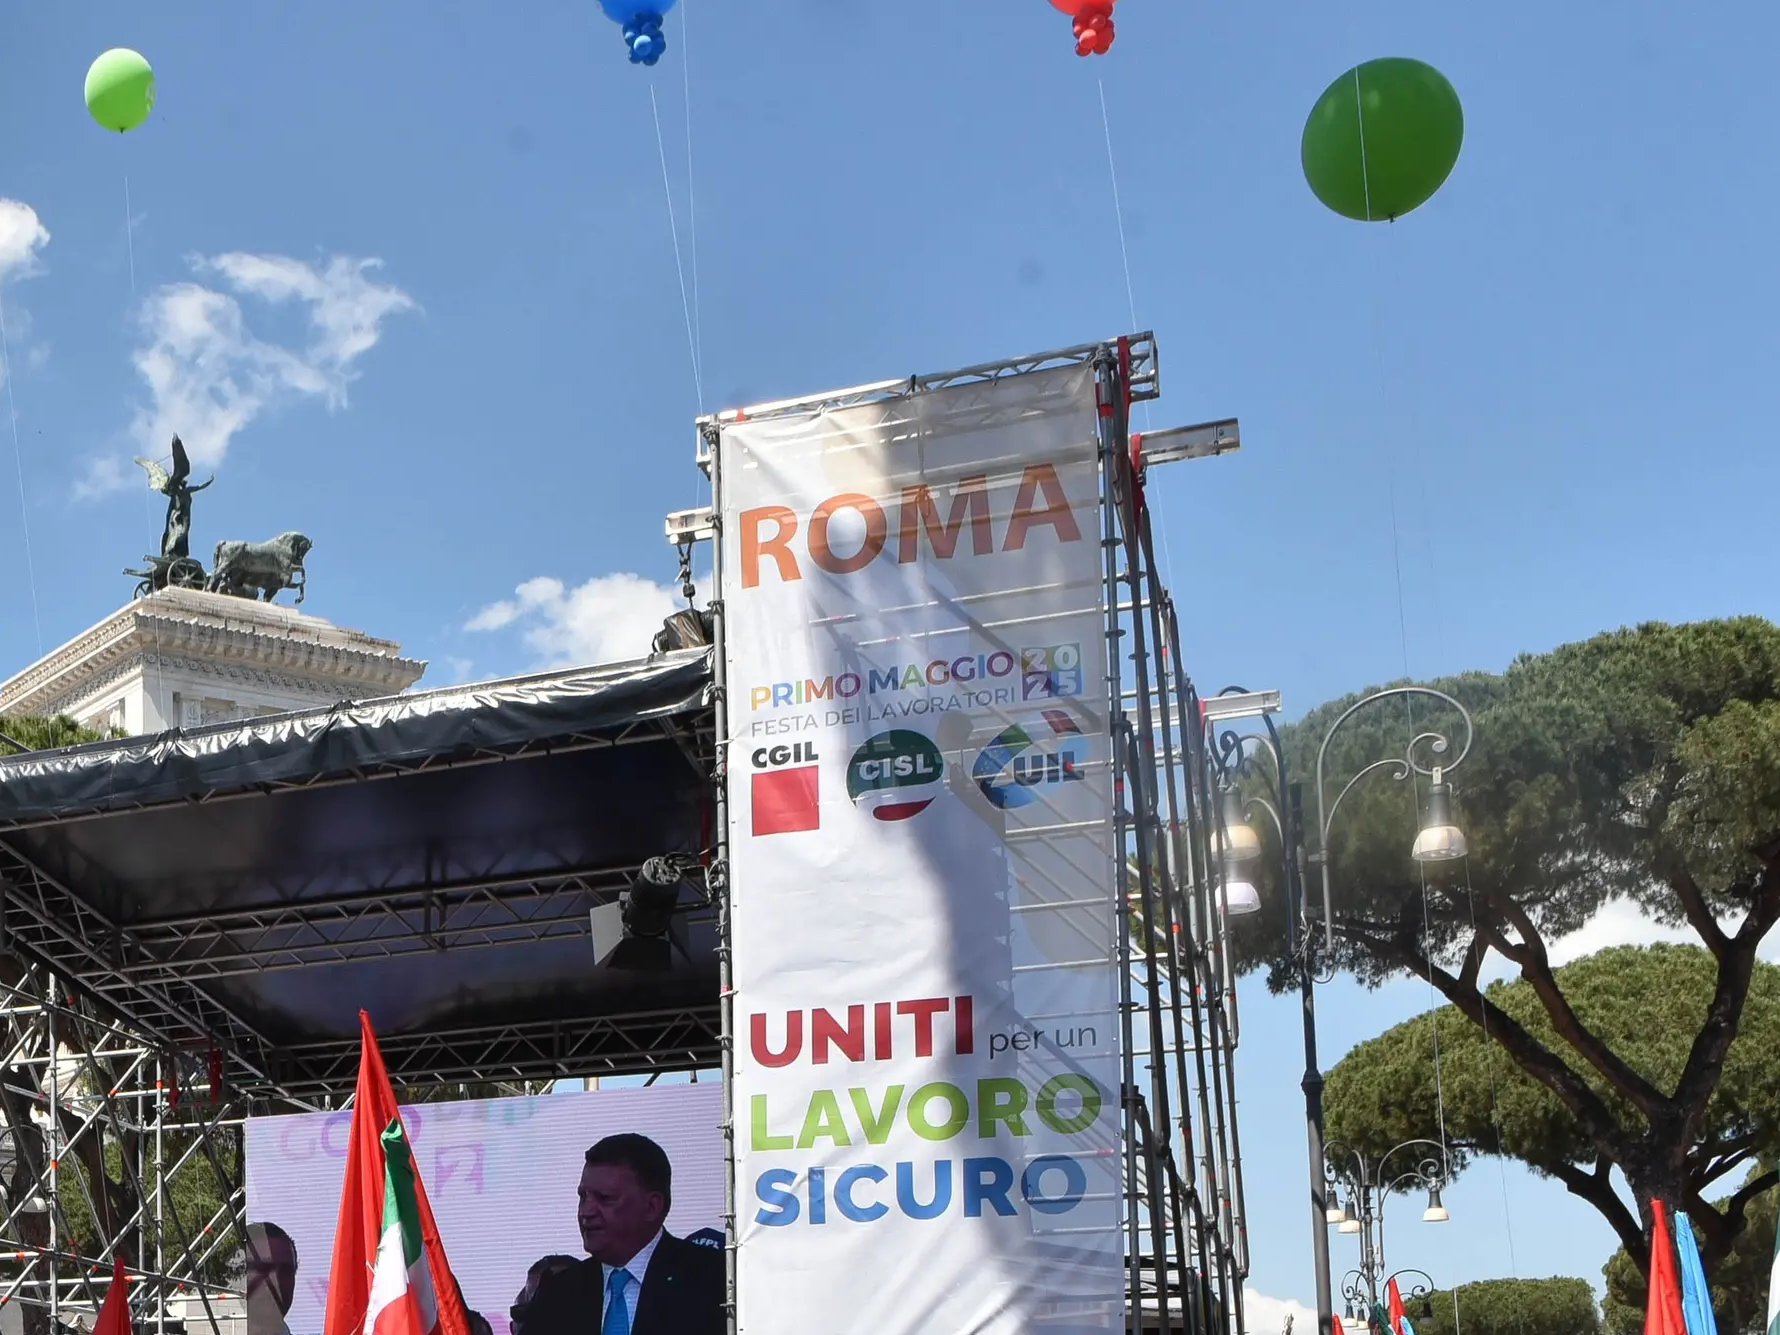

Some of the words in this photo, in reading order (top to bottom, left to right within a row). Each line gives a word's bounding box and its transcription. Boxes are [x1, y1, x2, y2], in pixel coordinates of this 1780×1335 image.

[739, 463, 1083, 589] ROMA
[751, 672, 862, 712] PRIMO
[869, 651, 1014, 694] MAGGIO
[751, 717, 818, 740] FESTA
[825, 708, 860, 726] DEI
[867, 686, 1016, 722] LAVORATORI
[751, 741, 819, 769] CGIL
[858, 752, 933, 782] CISL
[1013, 750, 1085, 787] UIL
[750, 995, 973, 1068] UNITI
[989, 1030, 1045, 1060] per
[1055, 1024, 1097, 1048] un
[751, 1073, 1103, 1152] LAVORO
[753, 1154, 1088, 1227] SICURO
